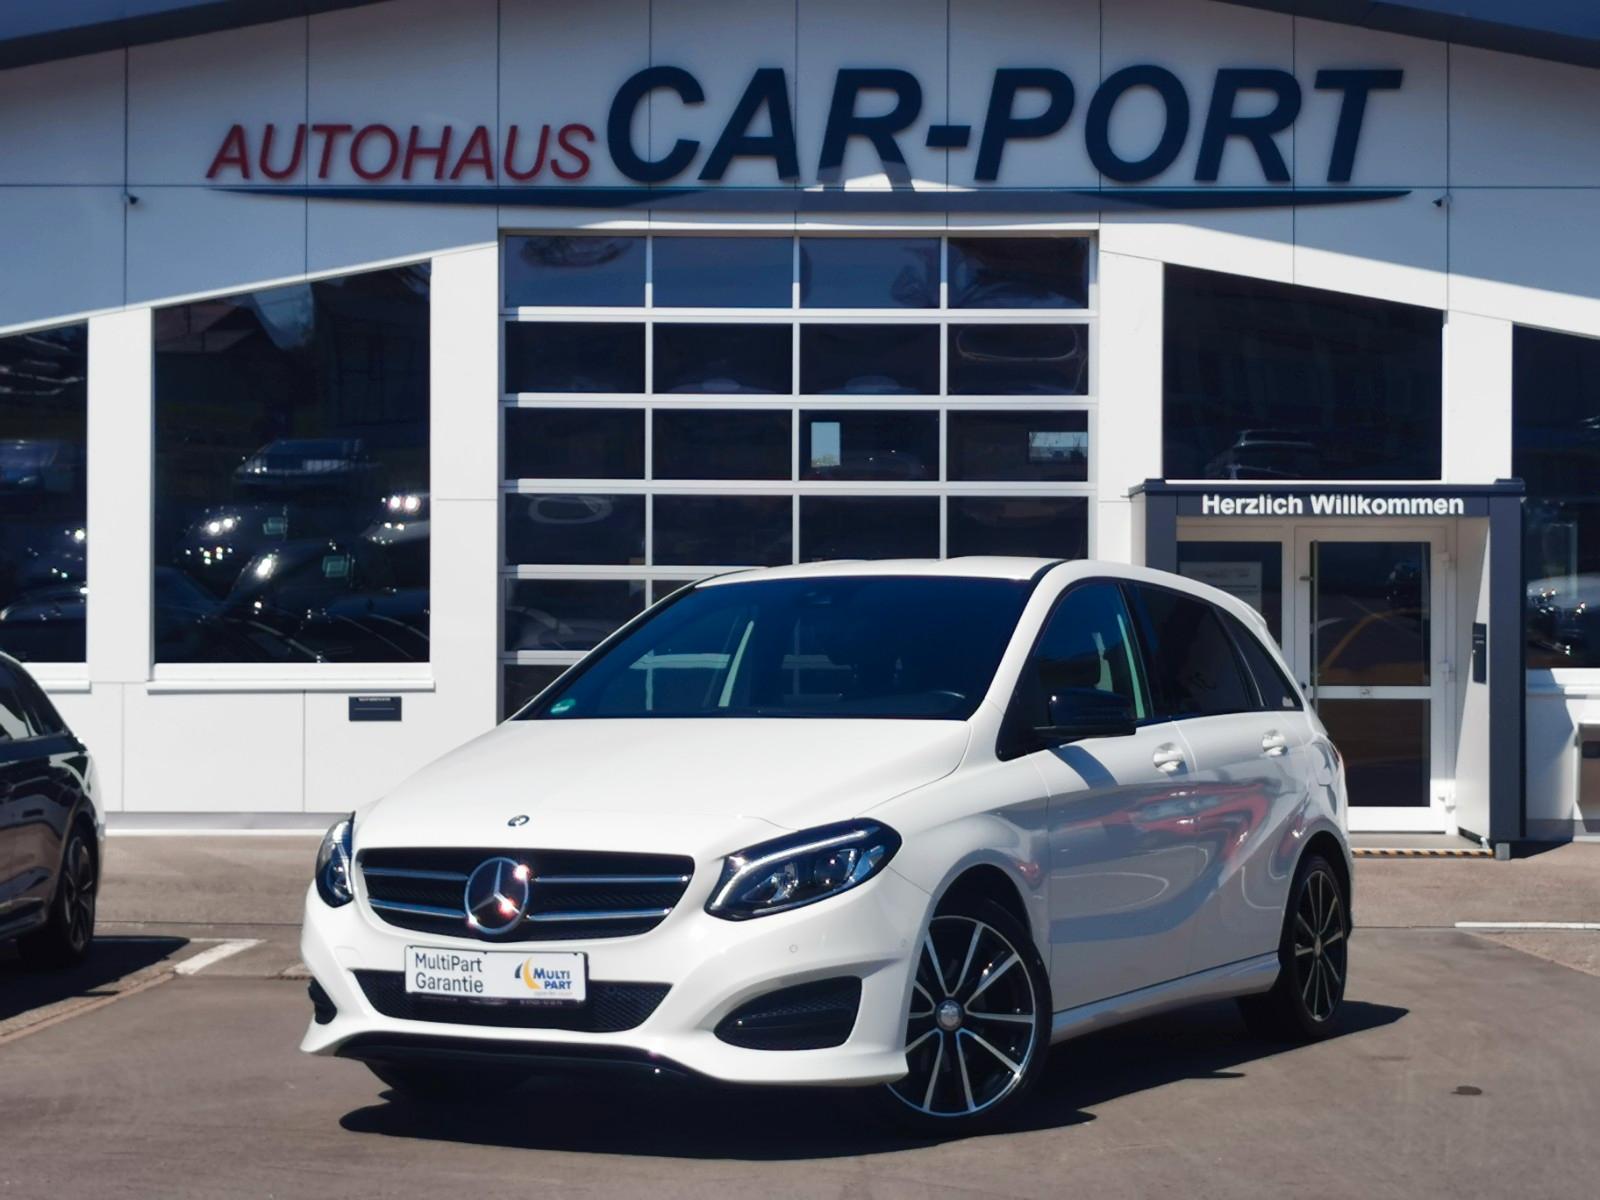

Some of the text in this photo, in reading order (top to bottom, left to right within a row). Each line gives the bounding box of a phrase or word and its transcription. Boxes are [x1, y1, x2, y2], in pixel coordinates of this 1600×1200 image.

[205, 64, 1404, 184] AUTOHAUS CAR-PORT
[1201, 494, 1465, 515] Herzlich Willkommen
[414, 952, 483, 974] MultiPart
[533, 967, 571, 980] MULTI
[415, 972, 484, 994] Garantie
[544, 980, 573, 990] PART
